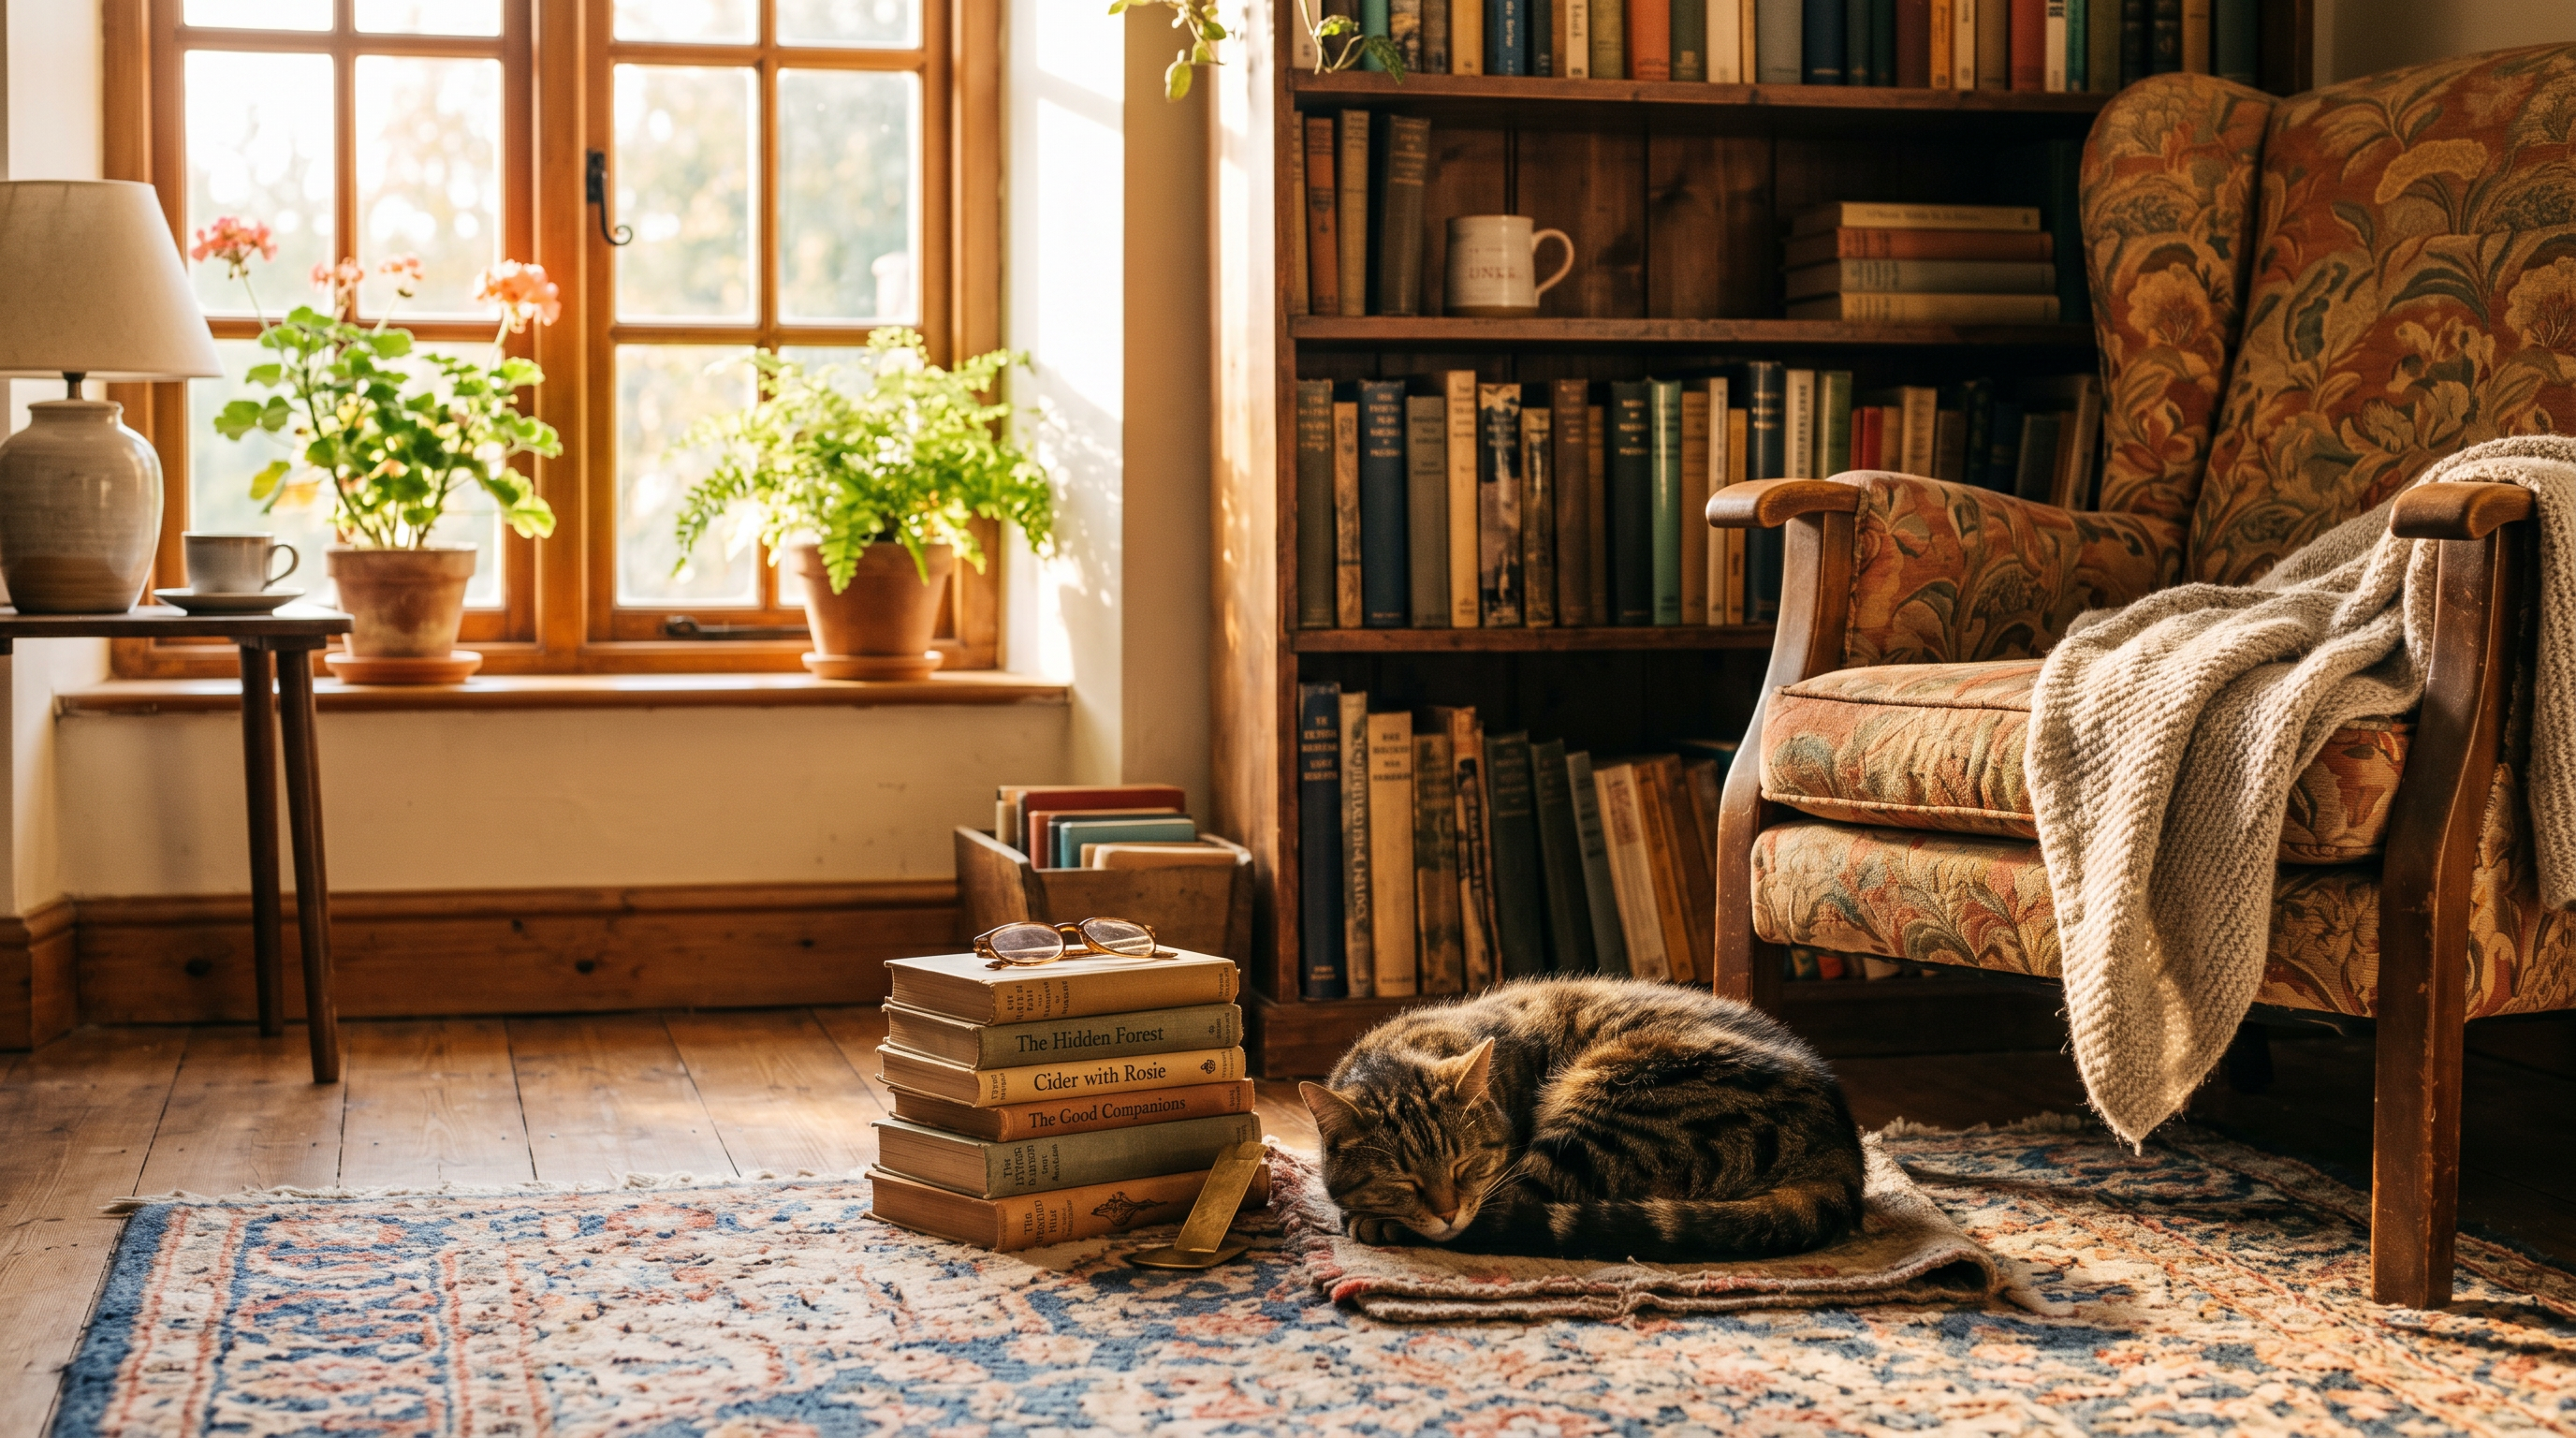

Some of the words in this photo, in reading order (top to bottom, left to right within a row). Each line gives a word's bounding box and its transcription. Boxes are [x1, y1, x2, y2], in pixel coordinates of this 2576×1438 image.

[1016, 1034, 1047, 1052] The
[1052, 1029, 1111, 1049] Hidden
[1115, 1026, 1164, 1045] Forest
[1033, 1072, 1078, 1092] Cider
[1083, 1066, 1120, 1086] with
[1123, 1061, 1166, 1082] Rosie
[1028, 1111, 1056, 1129] The
[1059, 1104, 1097, 1124] Good
[1101, 1097, 1186, 1120] Companions
